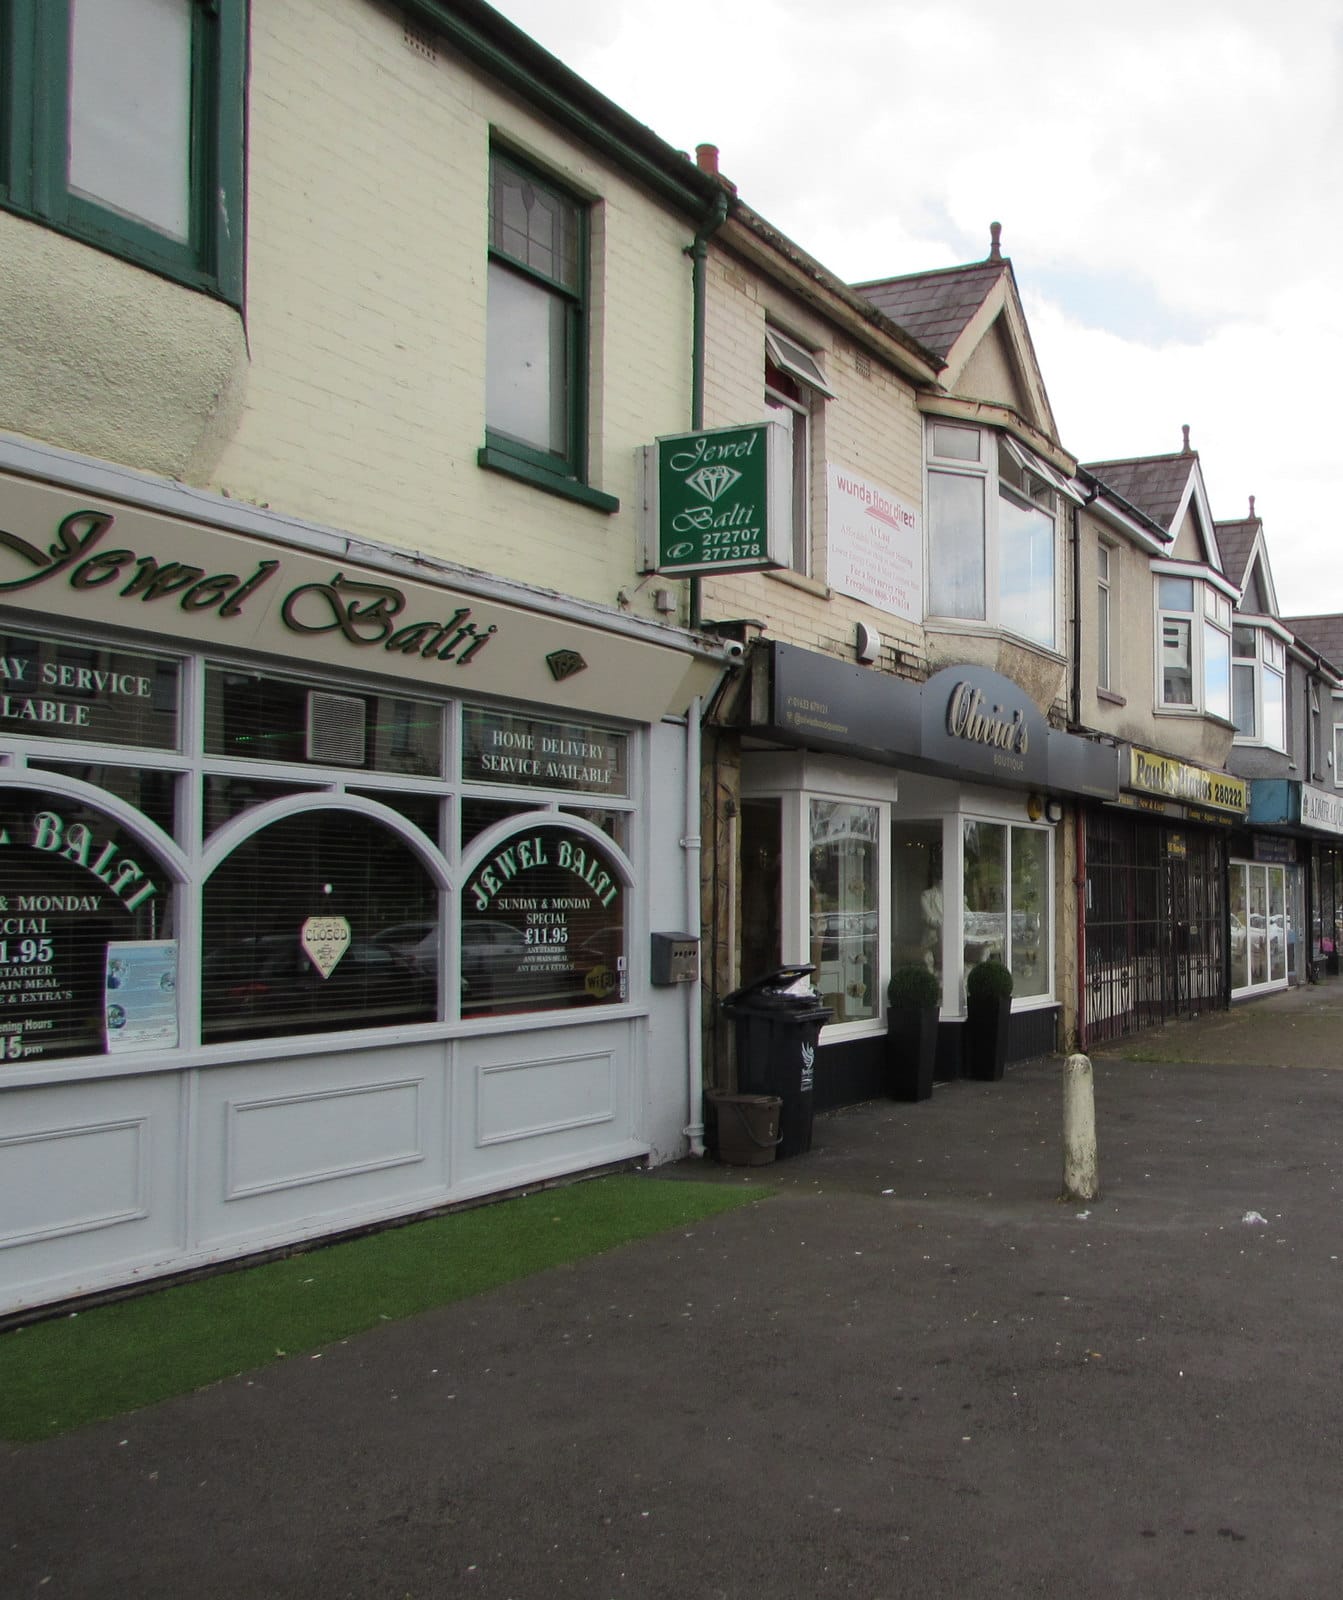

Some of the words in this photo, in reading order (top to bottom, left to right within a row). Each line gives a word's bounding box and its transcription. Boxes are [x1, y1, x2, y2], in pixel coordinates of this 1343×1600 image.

[670, 432, 757, 472] Jewel
[837, 476, 871, 504] wunda
[894, 504, 916, 529] direct
[672, 502, 755, 532] Balti
[702, 528, 760, 546] 272707
[702, 544, 760, 561] 277378
[0, 510, 279, 617] Jewel
[281, 572, 498, 665] Balti
[42, 663, 151, 697] SERVICE
[947, 681, 1029, 755] Olivia's
[493, 730, 535, 750] HOME
[542, 737, 604, 759] DELIVERY
[481, 754, 541, 776] SERVICE
[546, 762, 612, 784] AVAILABLE
[1214, 783, 1242, 808] 280222
[31, 811, 158, 912] BALTI
[471, 837, 549, 911] JEWEL
[557, 840, 619, 908] BALTI
[18, 896, 102, 911] MONDAY
[498, 898, 538, 910] SUNDAY
[541, 898, 548, 910] &
[551, 898, 591, 910] MONDAY
[0, 918, 52, 934] CIAL
[526, 913, 568, 925] SPECIAL
[305, 929, 347, 941] CLOSED
[524, 927, 568, 945] £11.95
[516, 964, 530, 972] ANY
[523, 955, 536, 963] ANY
[25, 978, 60, 989] MEAL
[8, 994, 17, 1003] &
[21, 990, 73, 1003] EXTRA'S
[25, 1019, 53, 1031] Hours
[24, 1045, 44, 1057] pm
